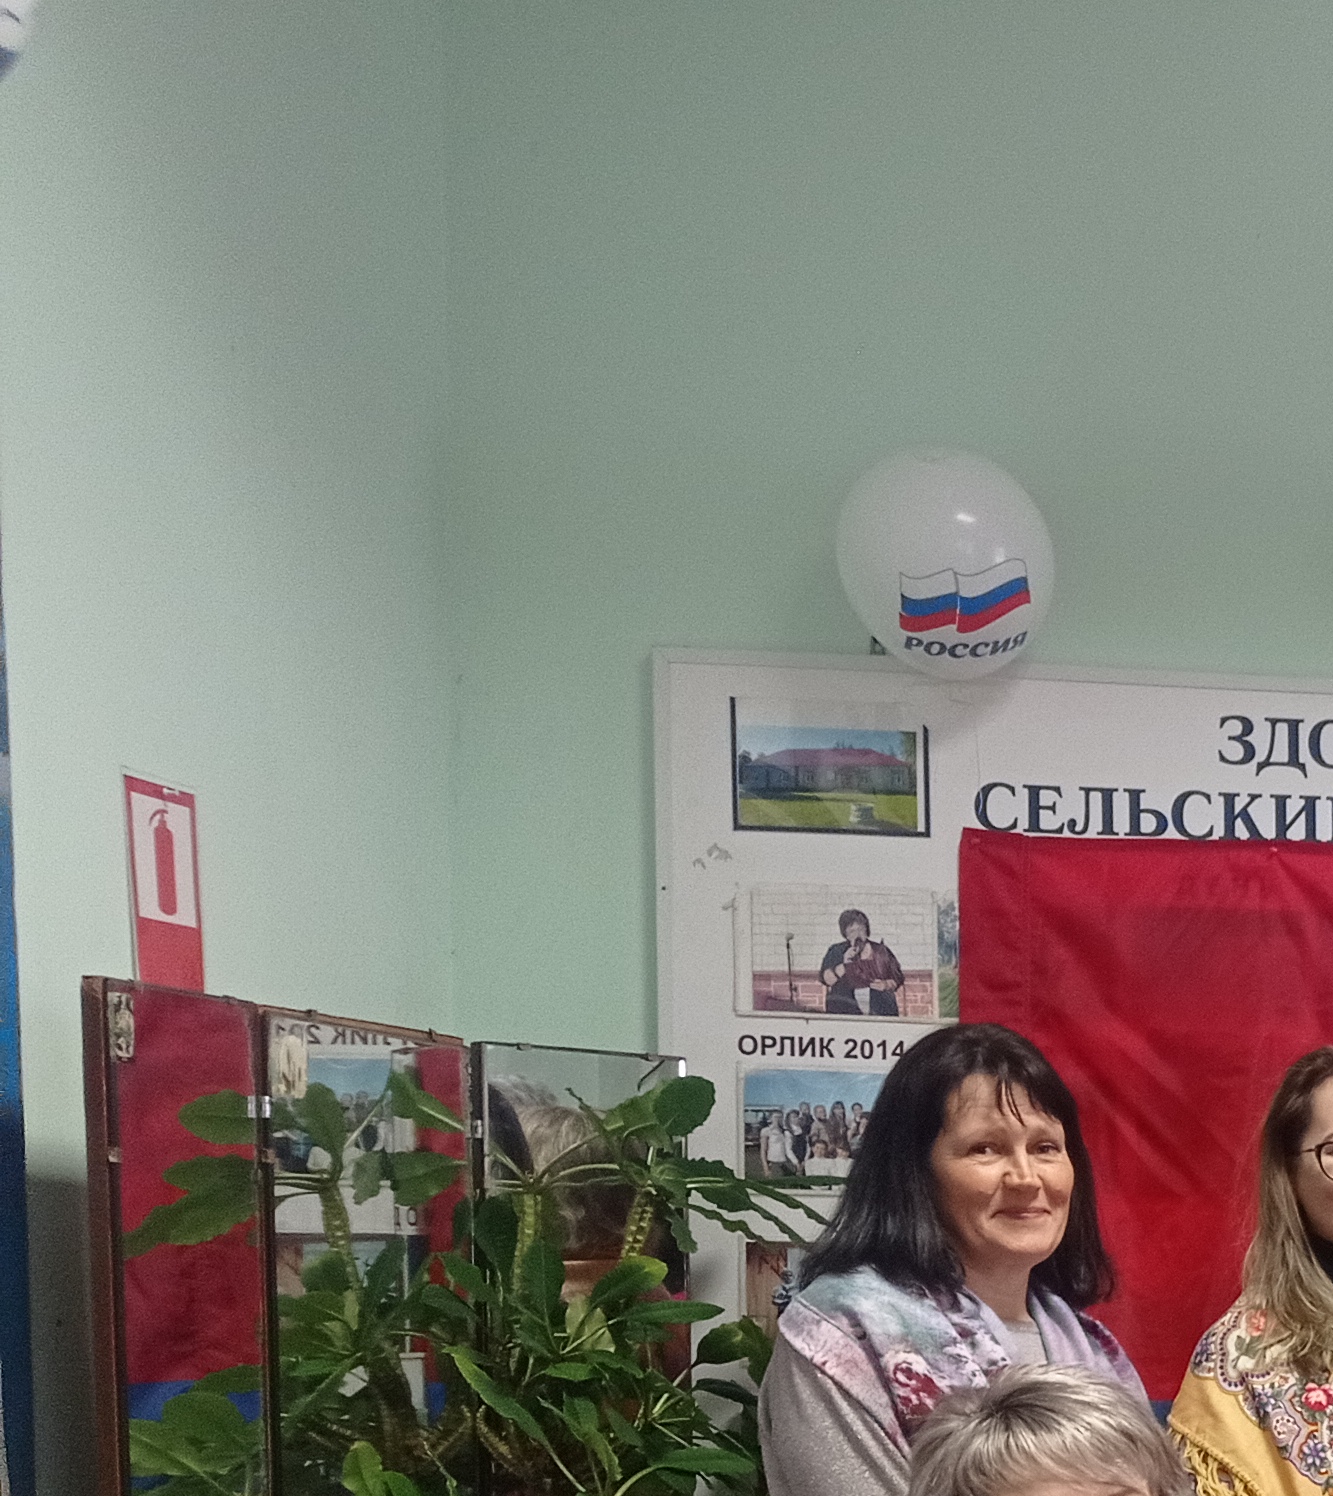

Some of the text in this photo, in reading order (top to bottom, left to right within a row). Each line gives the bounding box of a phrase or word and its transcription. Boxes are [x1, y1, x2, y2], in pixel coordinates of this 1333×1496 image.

[903, 630, 1028, 659] РОССИЯ
[738, 1035, 906, 1061] ОРЛИК 2014
